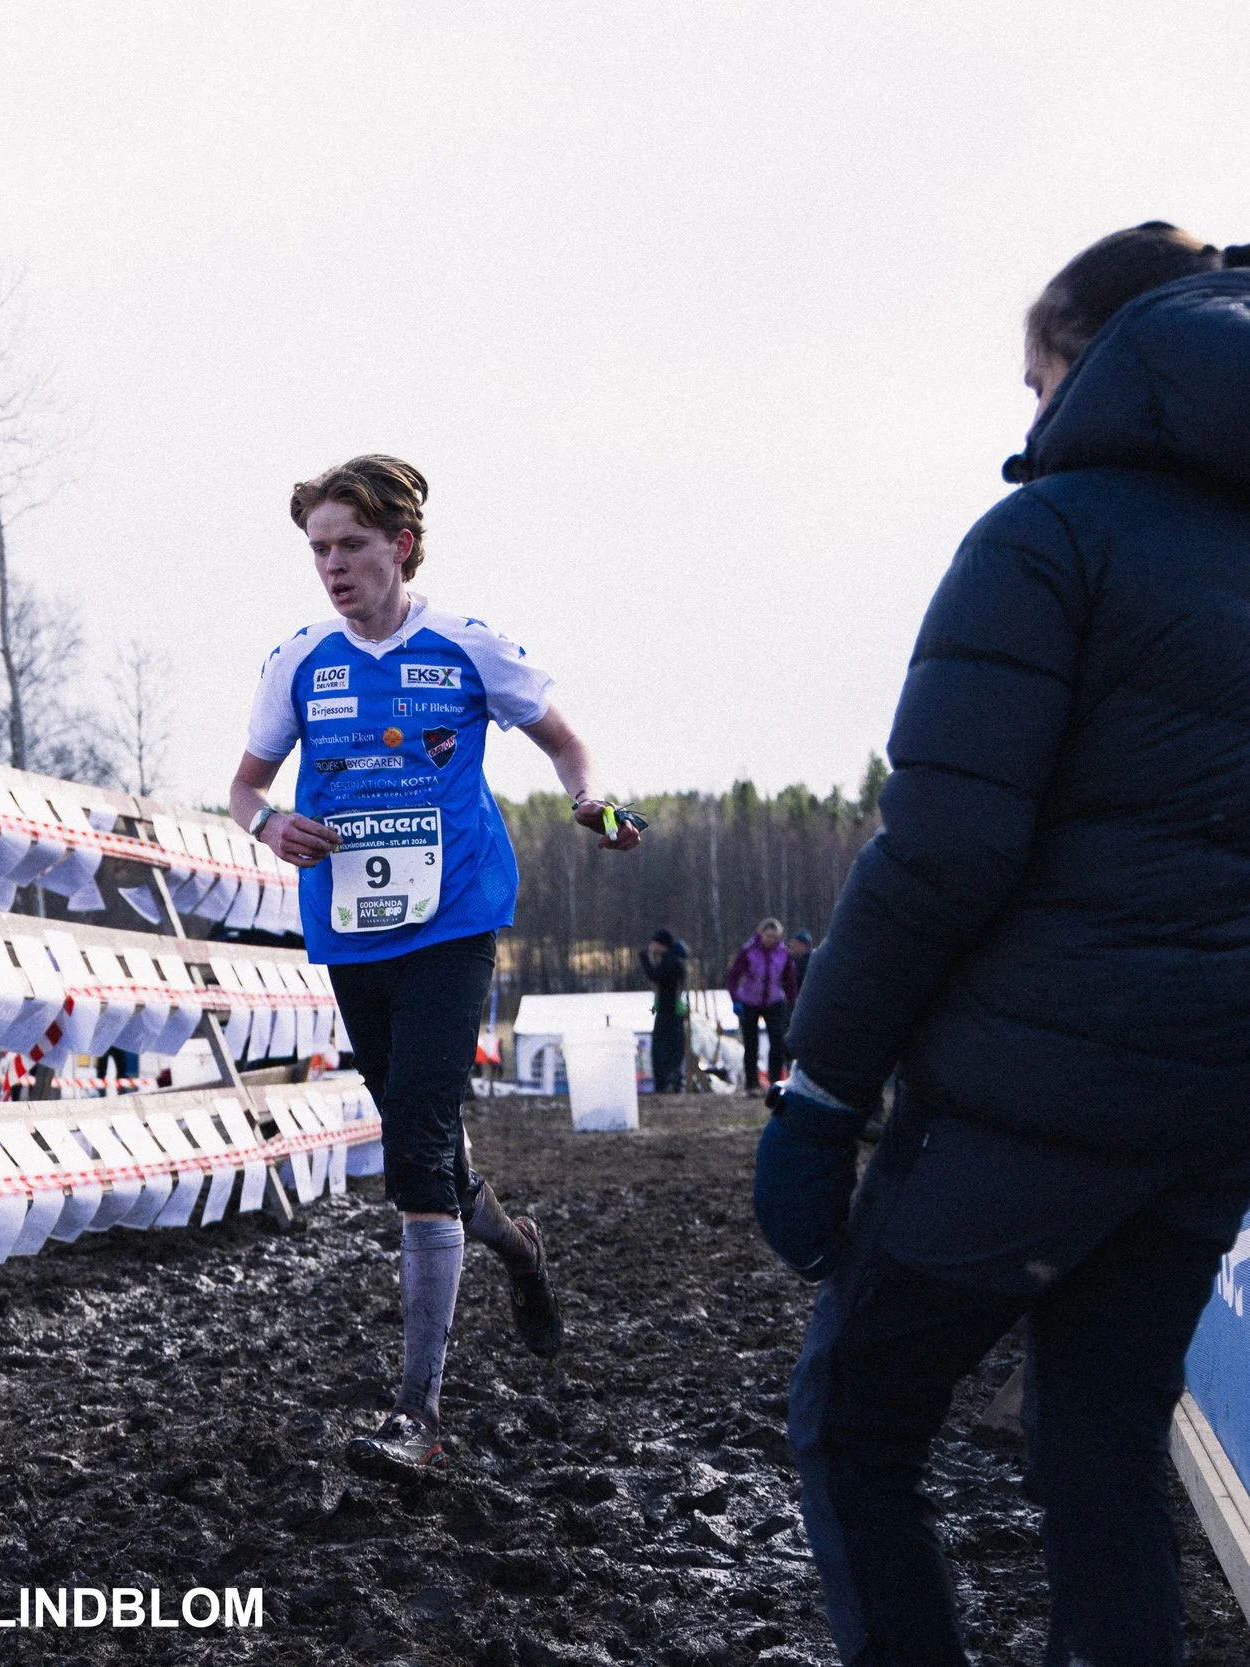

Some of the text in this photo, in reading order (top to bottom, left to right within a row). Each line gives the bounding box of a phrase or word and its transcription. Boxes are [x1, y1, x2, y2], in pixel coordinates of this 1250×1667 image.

[316, 682, 339, 690] DELIVER
[415, 703, 466, 714] LF Blekinge
[310, 732, 375, 747] Sparbanken Eken
[430, 737, 455, 755] ORION
[330, 776, 439, 792] DESTINATION KOSTA
[330, 816, 437, 839] bagheera
[424, 852, 436, 866] 3
[365, 856, 391, 889] 9
[359, 898, 403, 909] GODKÄNDA
